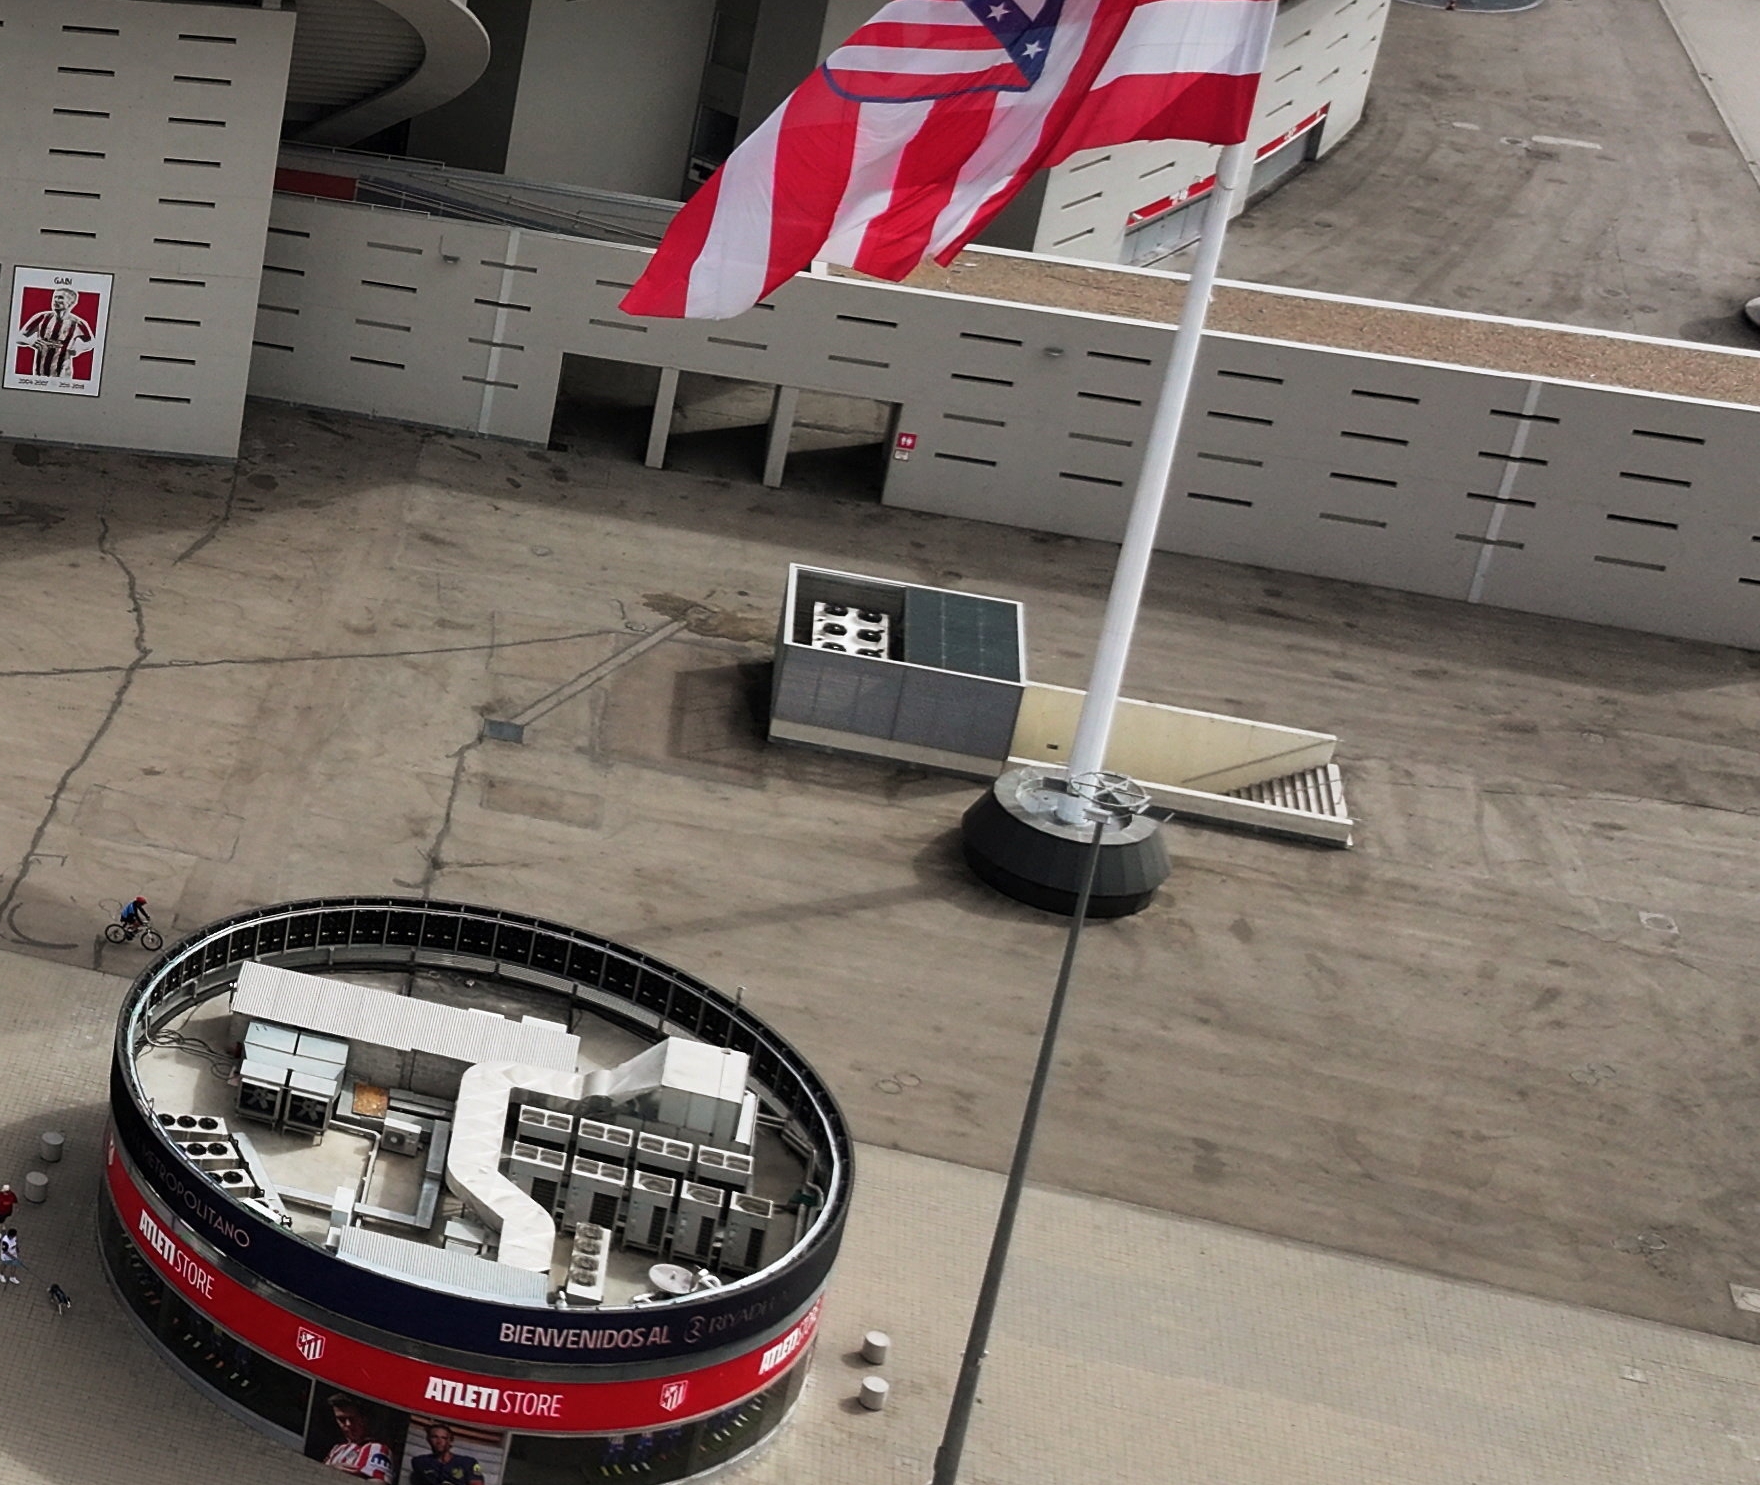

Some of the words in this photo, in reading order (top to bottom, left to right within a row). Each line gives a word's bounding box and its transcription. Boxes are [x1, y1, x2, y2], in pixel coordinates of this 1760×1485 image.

[139, 1208, 176, 1266] ATLETI
[174, 1250, 215, 1300] STORE
[499, 1323, 645, 1349] BIENVENIDOS
[646, 1325, 672, 1346] AL
[424, 1376, 500, 1412] ATLETI
[500, 1390, 564, 1417] STORE
